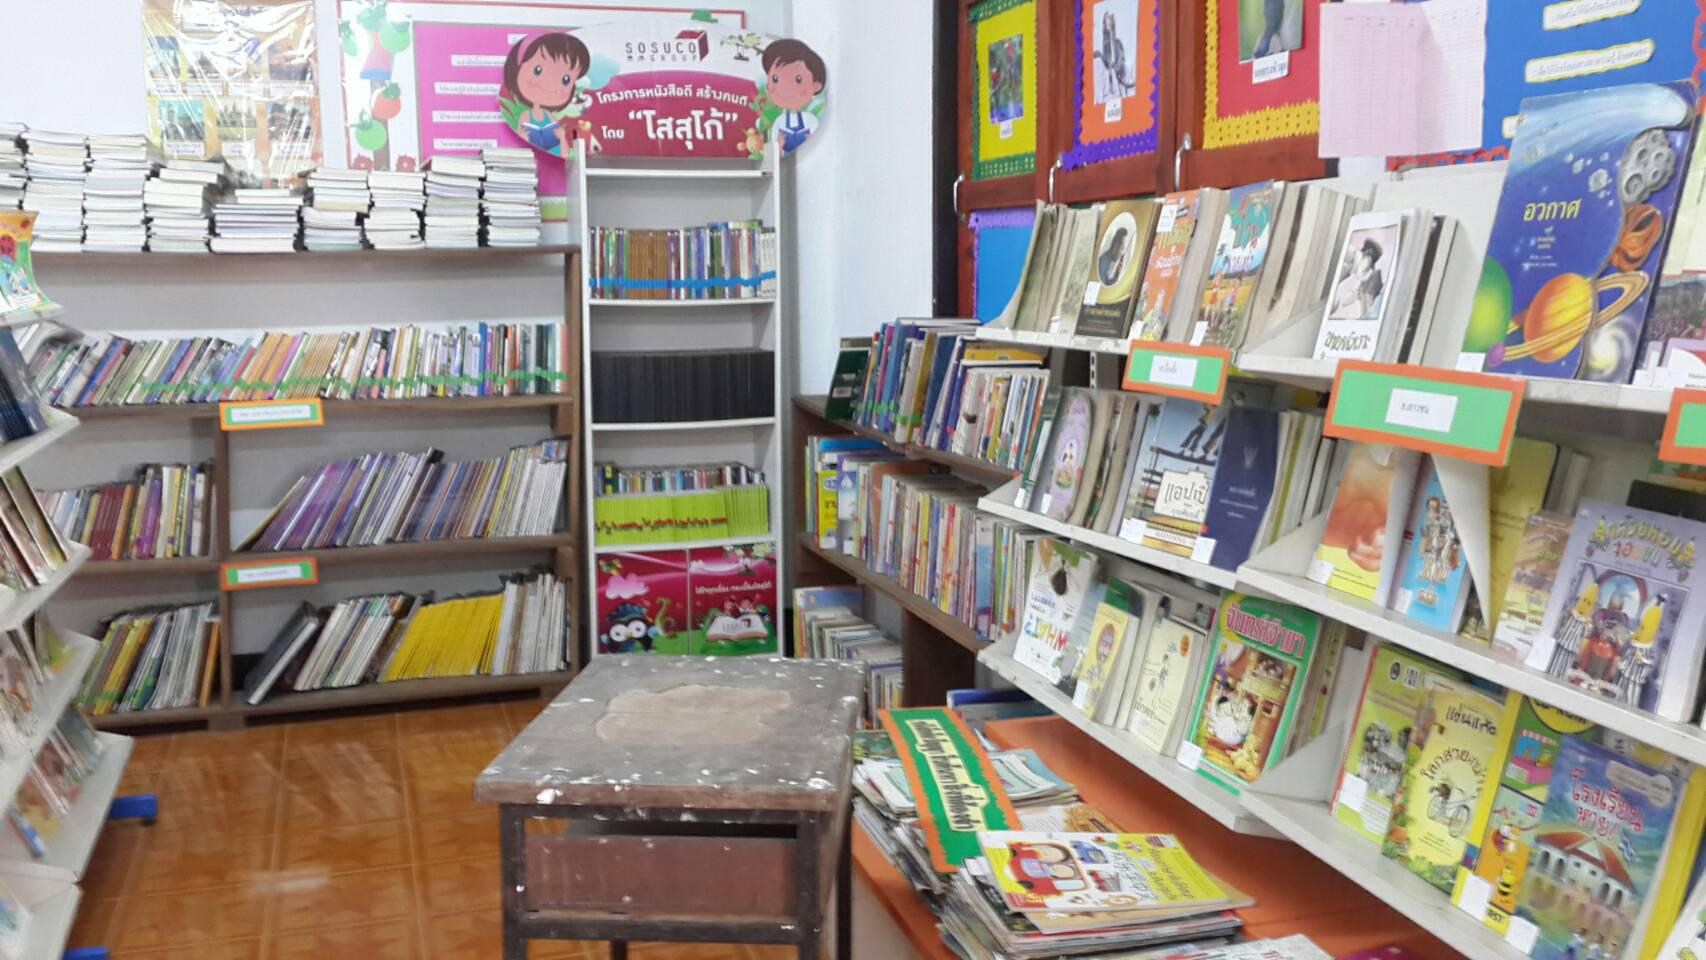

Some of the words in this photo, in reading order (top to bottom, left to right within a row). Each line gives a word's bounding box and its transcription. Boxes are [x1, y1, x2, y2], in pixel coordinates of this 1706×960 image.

[625, 41, 697, 54] SOSUCO
[649, 54, 698, 62] GROUP
[602, 125, 625, 140] โดย
[1523, 199, 1581, 222] อวกาศ
